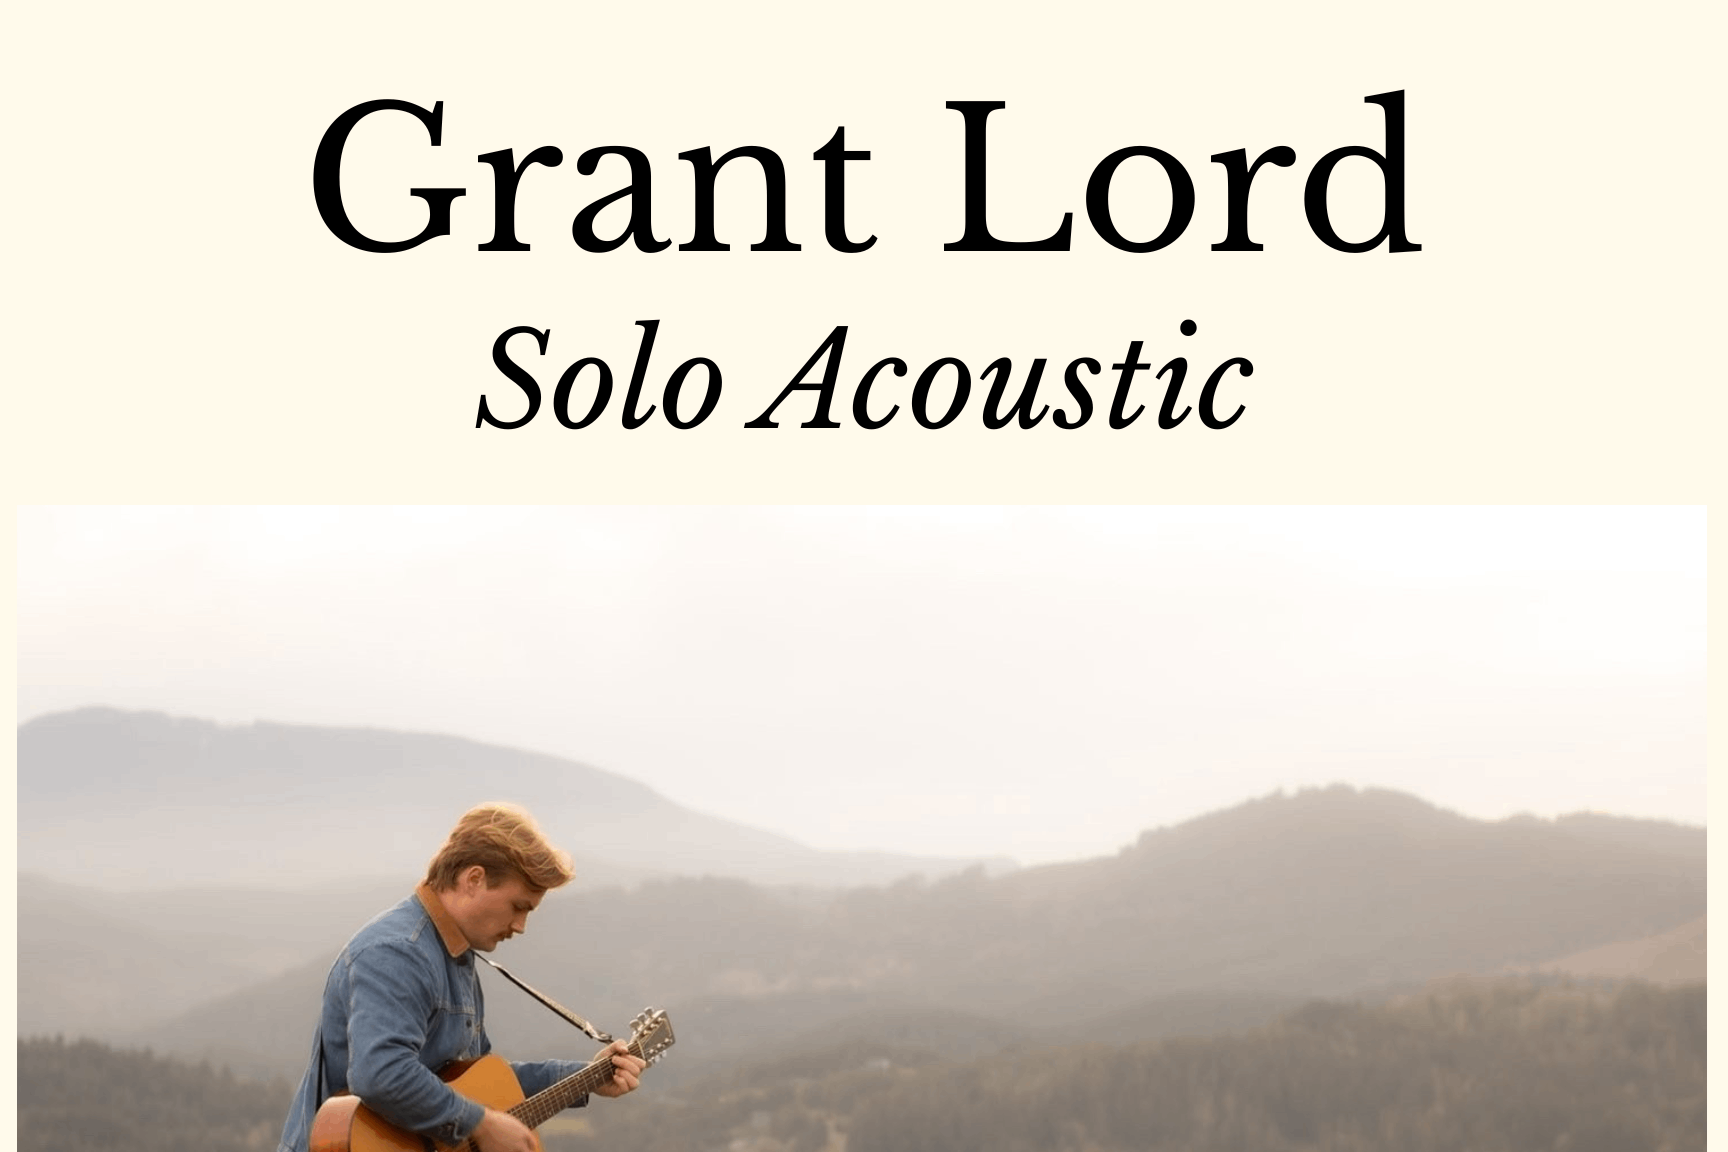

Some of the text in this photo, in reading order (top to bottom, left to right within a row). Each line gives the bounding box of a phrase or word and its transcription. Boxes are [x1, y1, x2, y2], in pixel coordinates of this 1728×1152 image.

[313, 90, 1422, 253] Grant Lord
[476, 320, 1253, 429] Solo Acoustic
